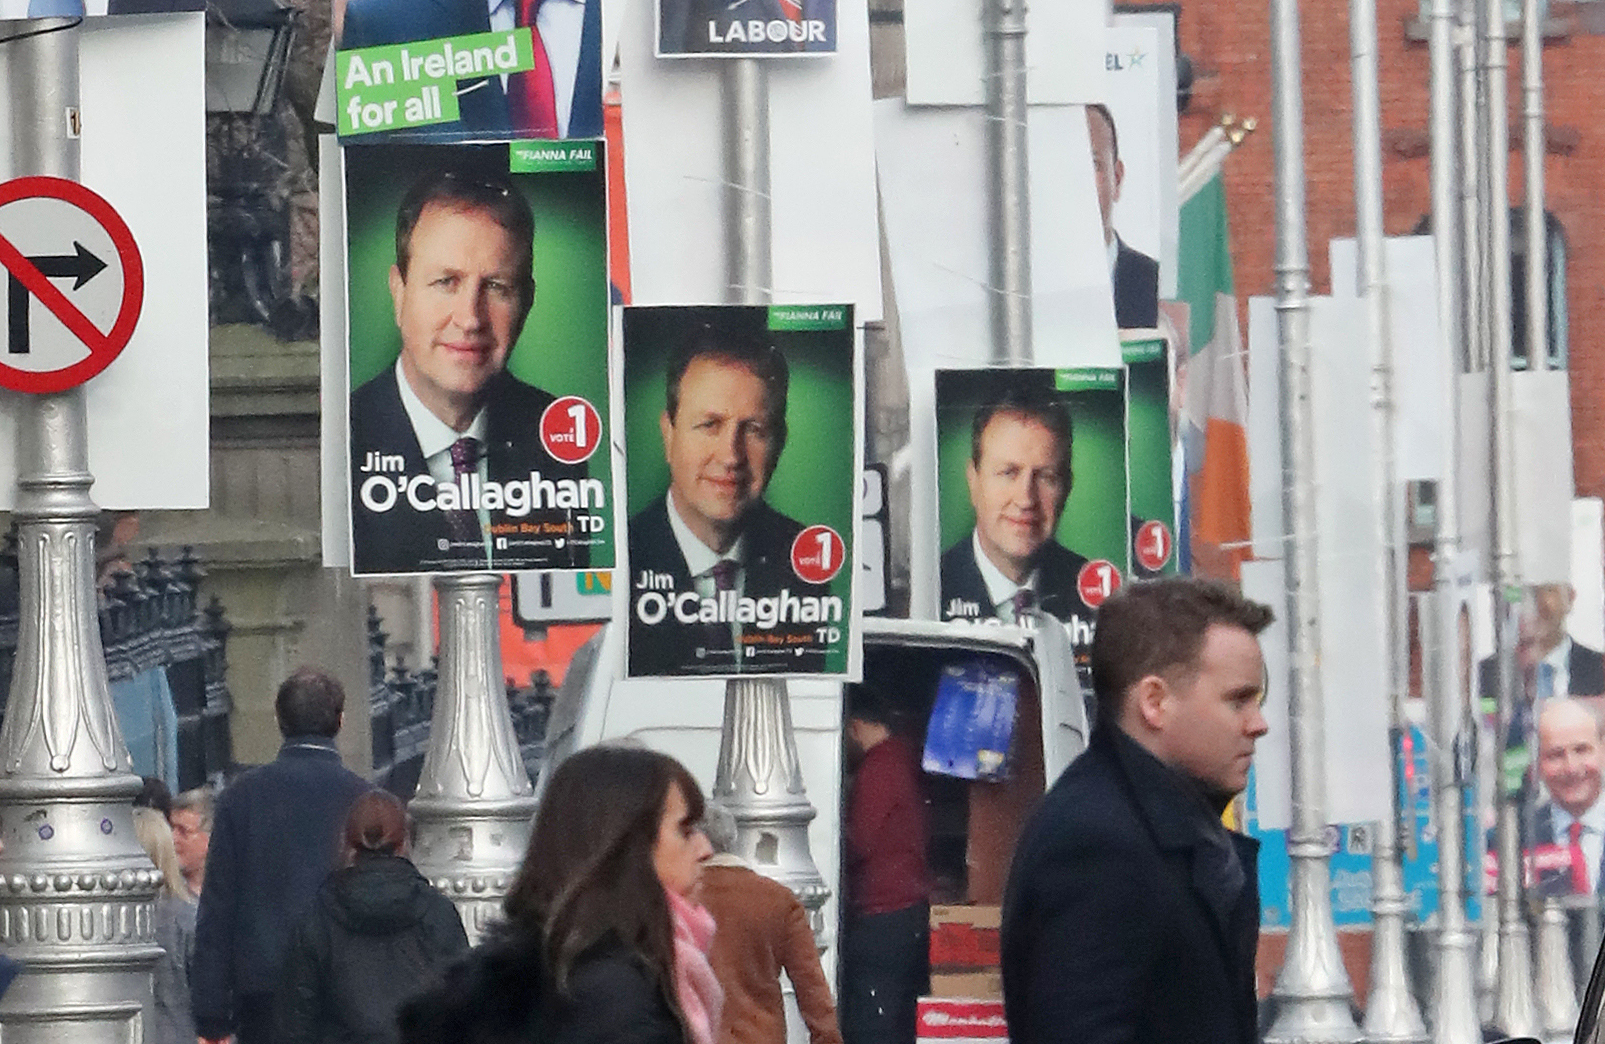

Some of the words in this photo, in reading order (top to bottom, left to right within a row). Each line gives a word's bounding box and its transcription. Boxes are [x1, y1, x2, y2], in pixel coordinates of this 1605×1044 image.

[708, 19, 827, 43] LABOUR
[344, 54, 395, 90] An
[400, 34, 519, 82] Ireland
[346, 94, 398, 130] for
[404, 85, 442, 123] all
[567, 403, 587, 449] 1
[360, 451, 405, 473] Jim
[360, 471, 605, 517] O'Callaghan
[577, 515, 605, 533] TD
[814, 531, 832, 571] 1
[1151, 525, 1163, 560] 1
[636, 569, 675, 589] Jim
[1096, 565, 1112, 598] 1
[636, 588, 843, 629] O'Callaghan
[816, 626, 841, 644] TD
